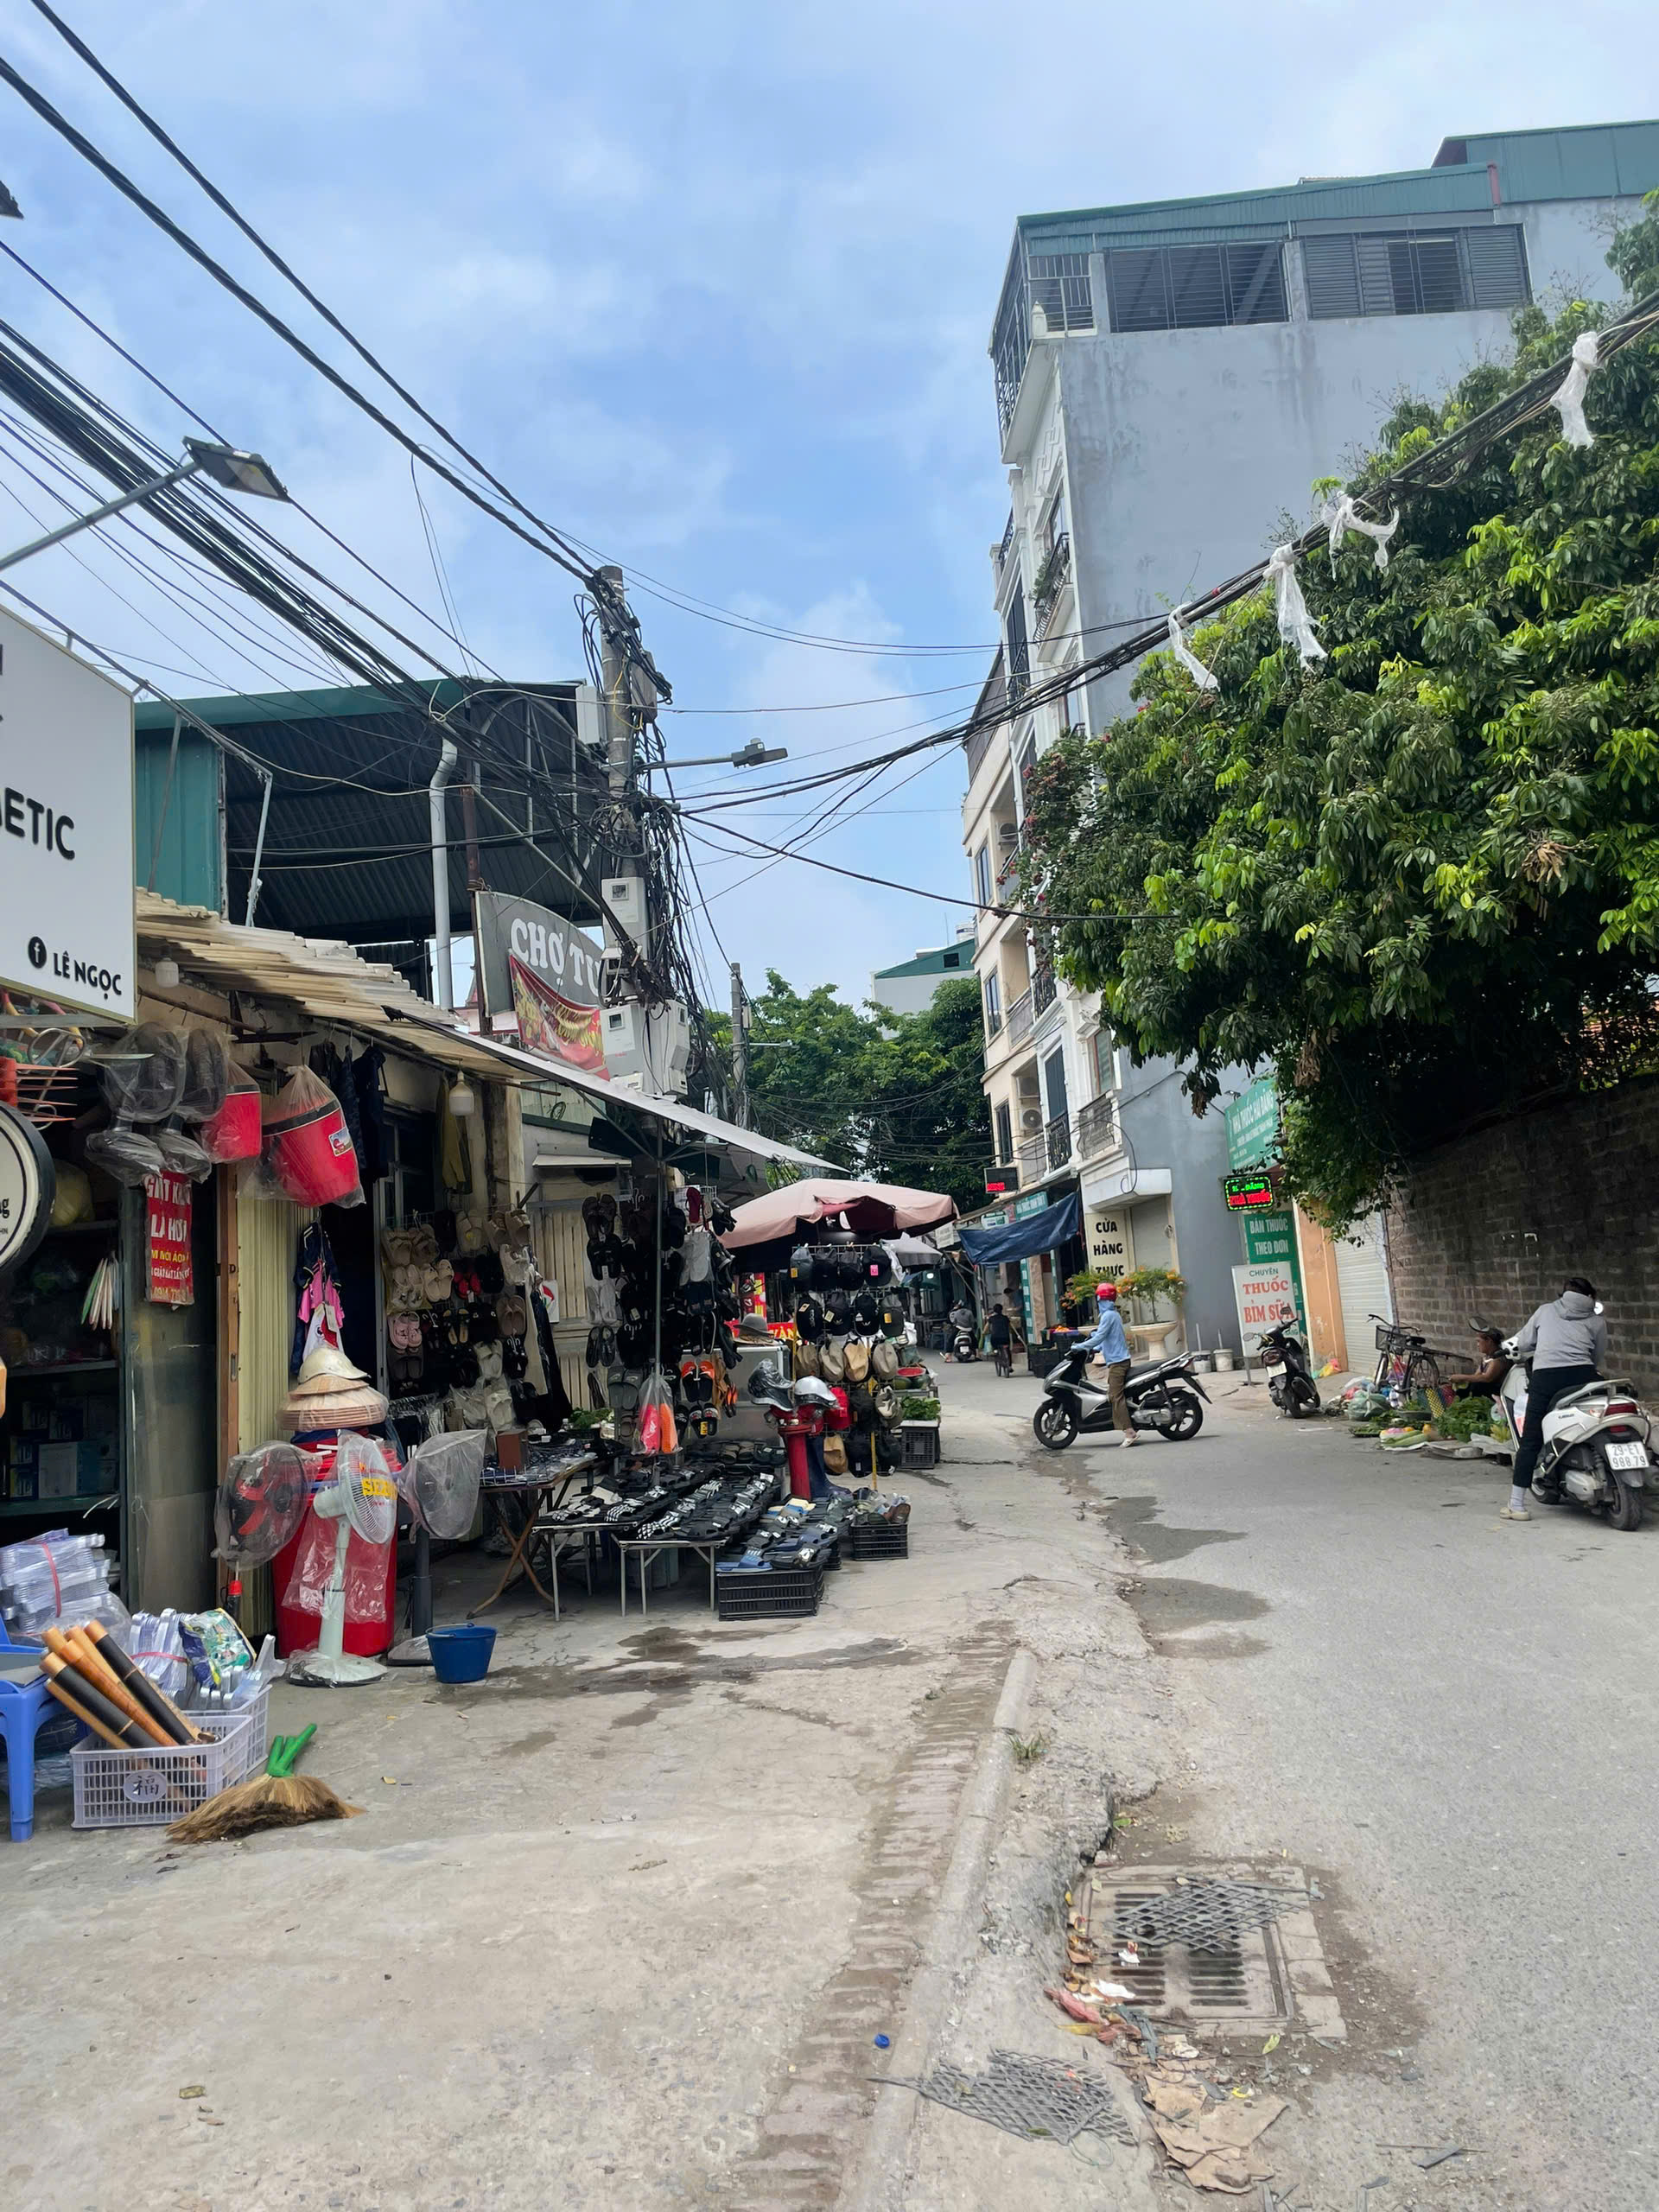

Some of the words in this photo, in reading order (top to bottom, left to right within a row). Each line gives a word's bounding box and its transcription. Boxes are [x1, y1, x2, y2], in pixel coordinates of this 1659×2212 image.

[0, 787, 75, 861] ETIC
[510, 918, 565, 987] CHỢ
[53, 951, 71, 979] LÊ
[74, 960, 122, 1000] NGỌC
[1096, 1217, 1117, 1233] CỬA
[1265, 1215, 1288, 1233] THUỐC
[1093, 1240, 1123, 1255] HÀNG
[1255, 1241, 1273, 1255] THEO
[1249, 1267, 1279, 1277] CHUYÊN
[1243, 1275, 1289, 1294] THUỐC
[132, 1775, 160, 1796] 福
